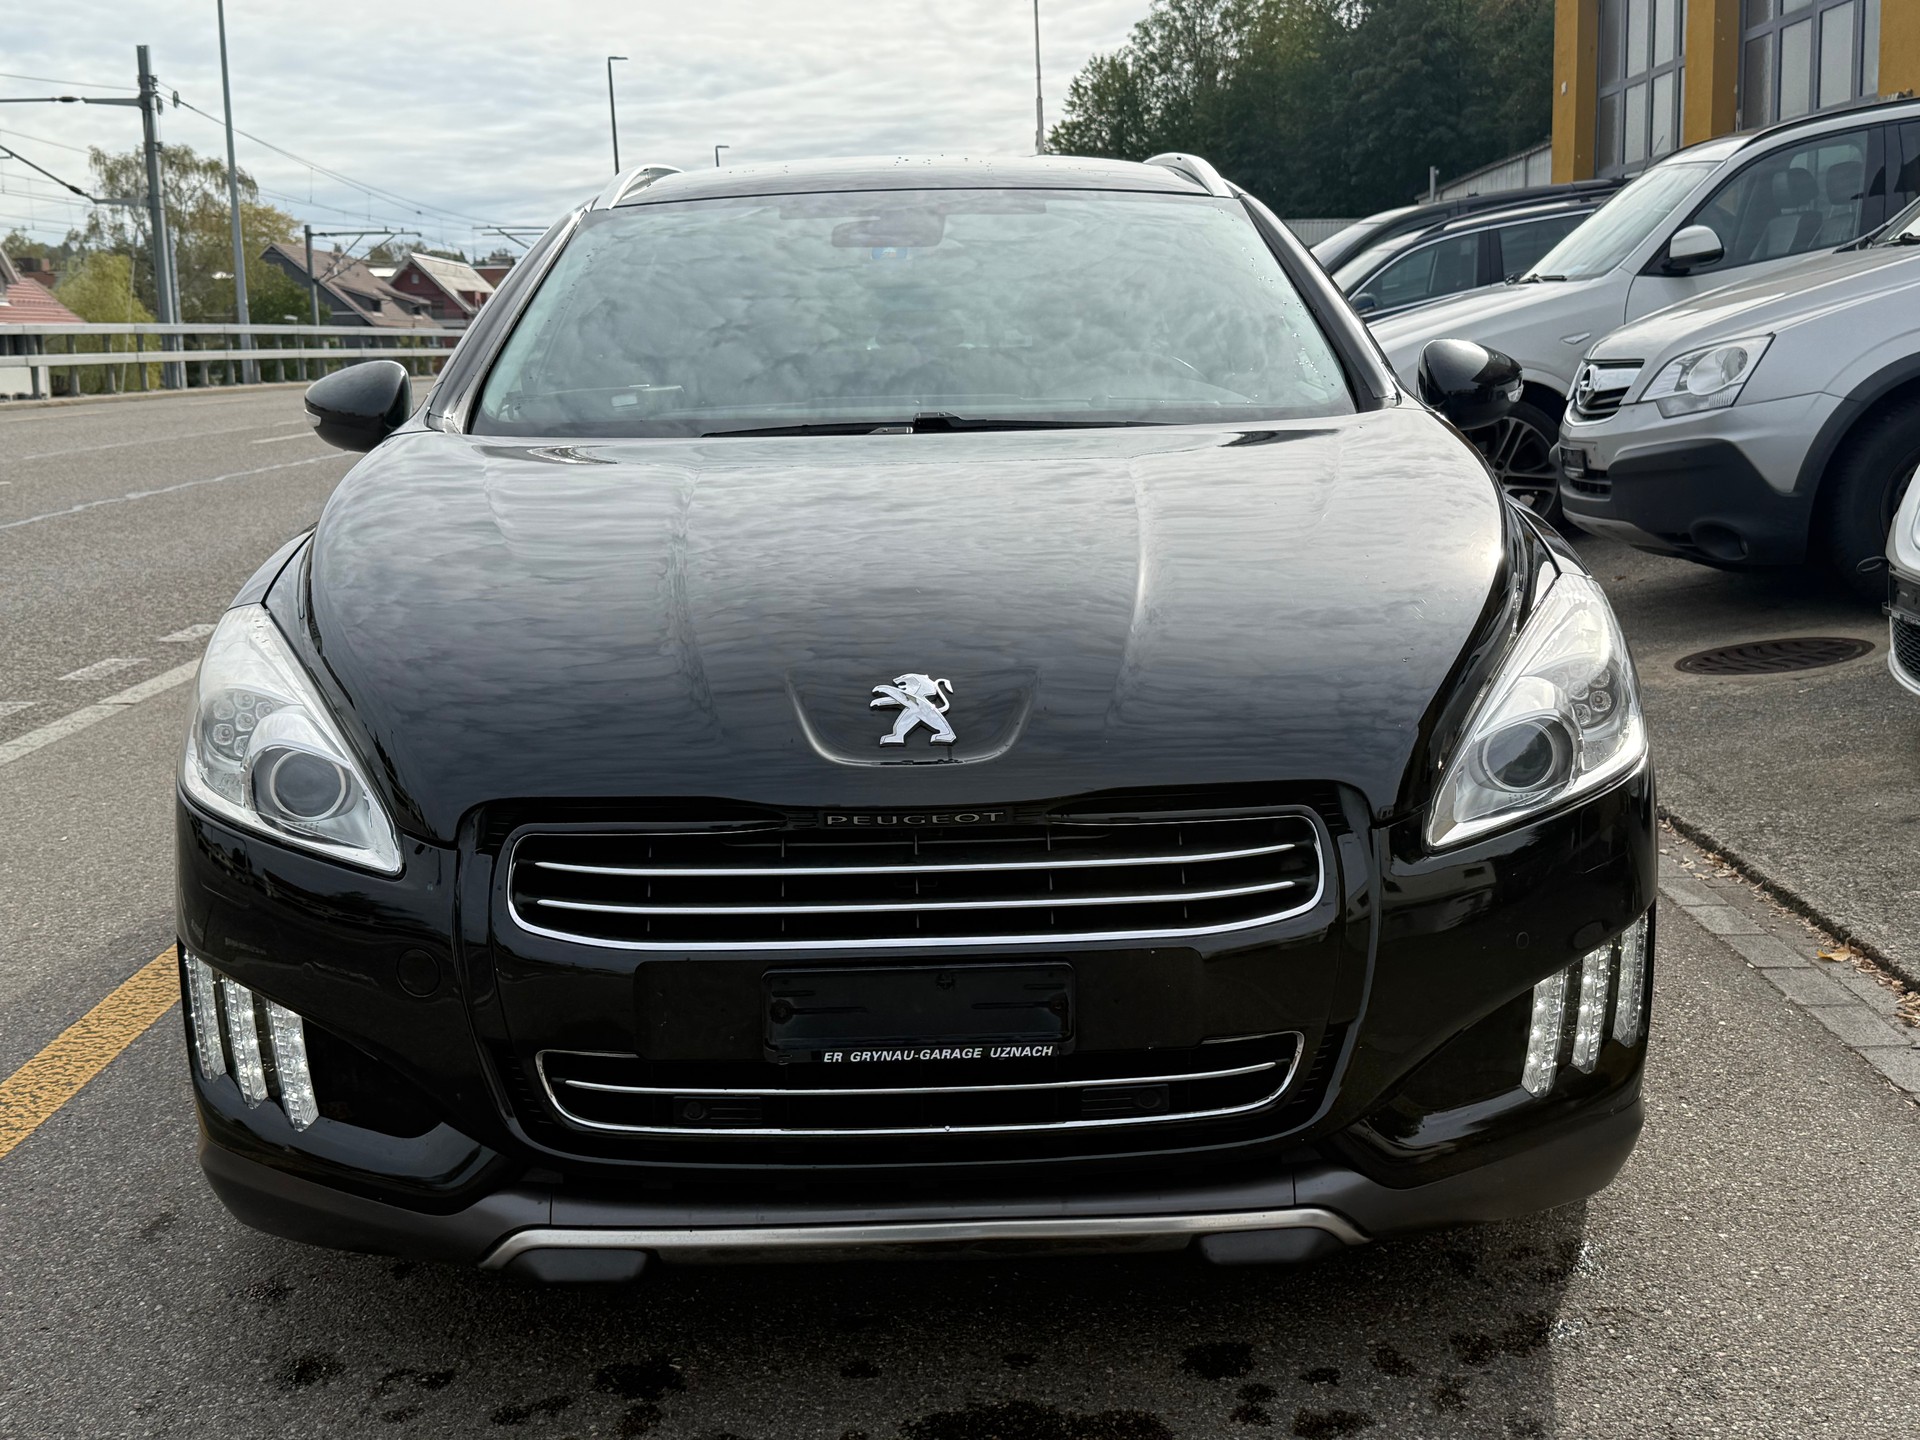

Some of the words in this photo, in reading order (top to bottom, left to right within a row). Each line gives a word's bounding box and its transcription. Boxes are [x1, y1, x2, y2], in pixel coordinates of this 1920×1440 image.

[827, 812, 1004, 825] PEUGEOT
[823, 1052, 843, 1062] ER
[850, 1048, 983, 1062] GRYNAU-GARAGE
[990, 1046, 1053, 1058] UZNACH
